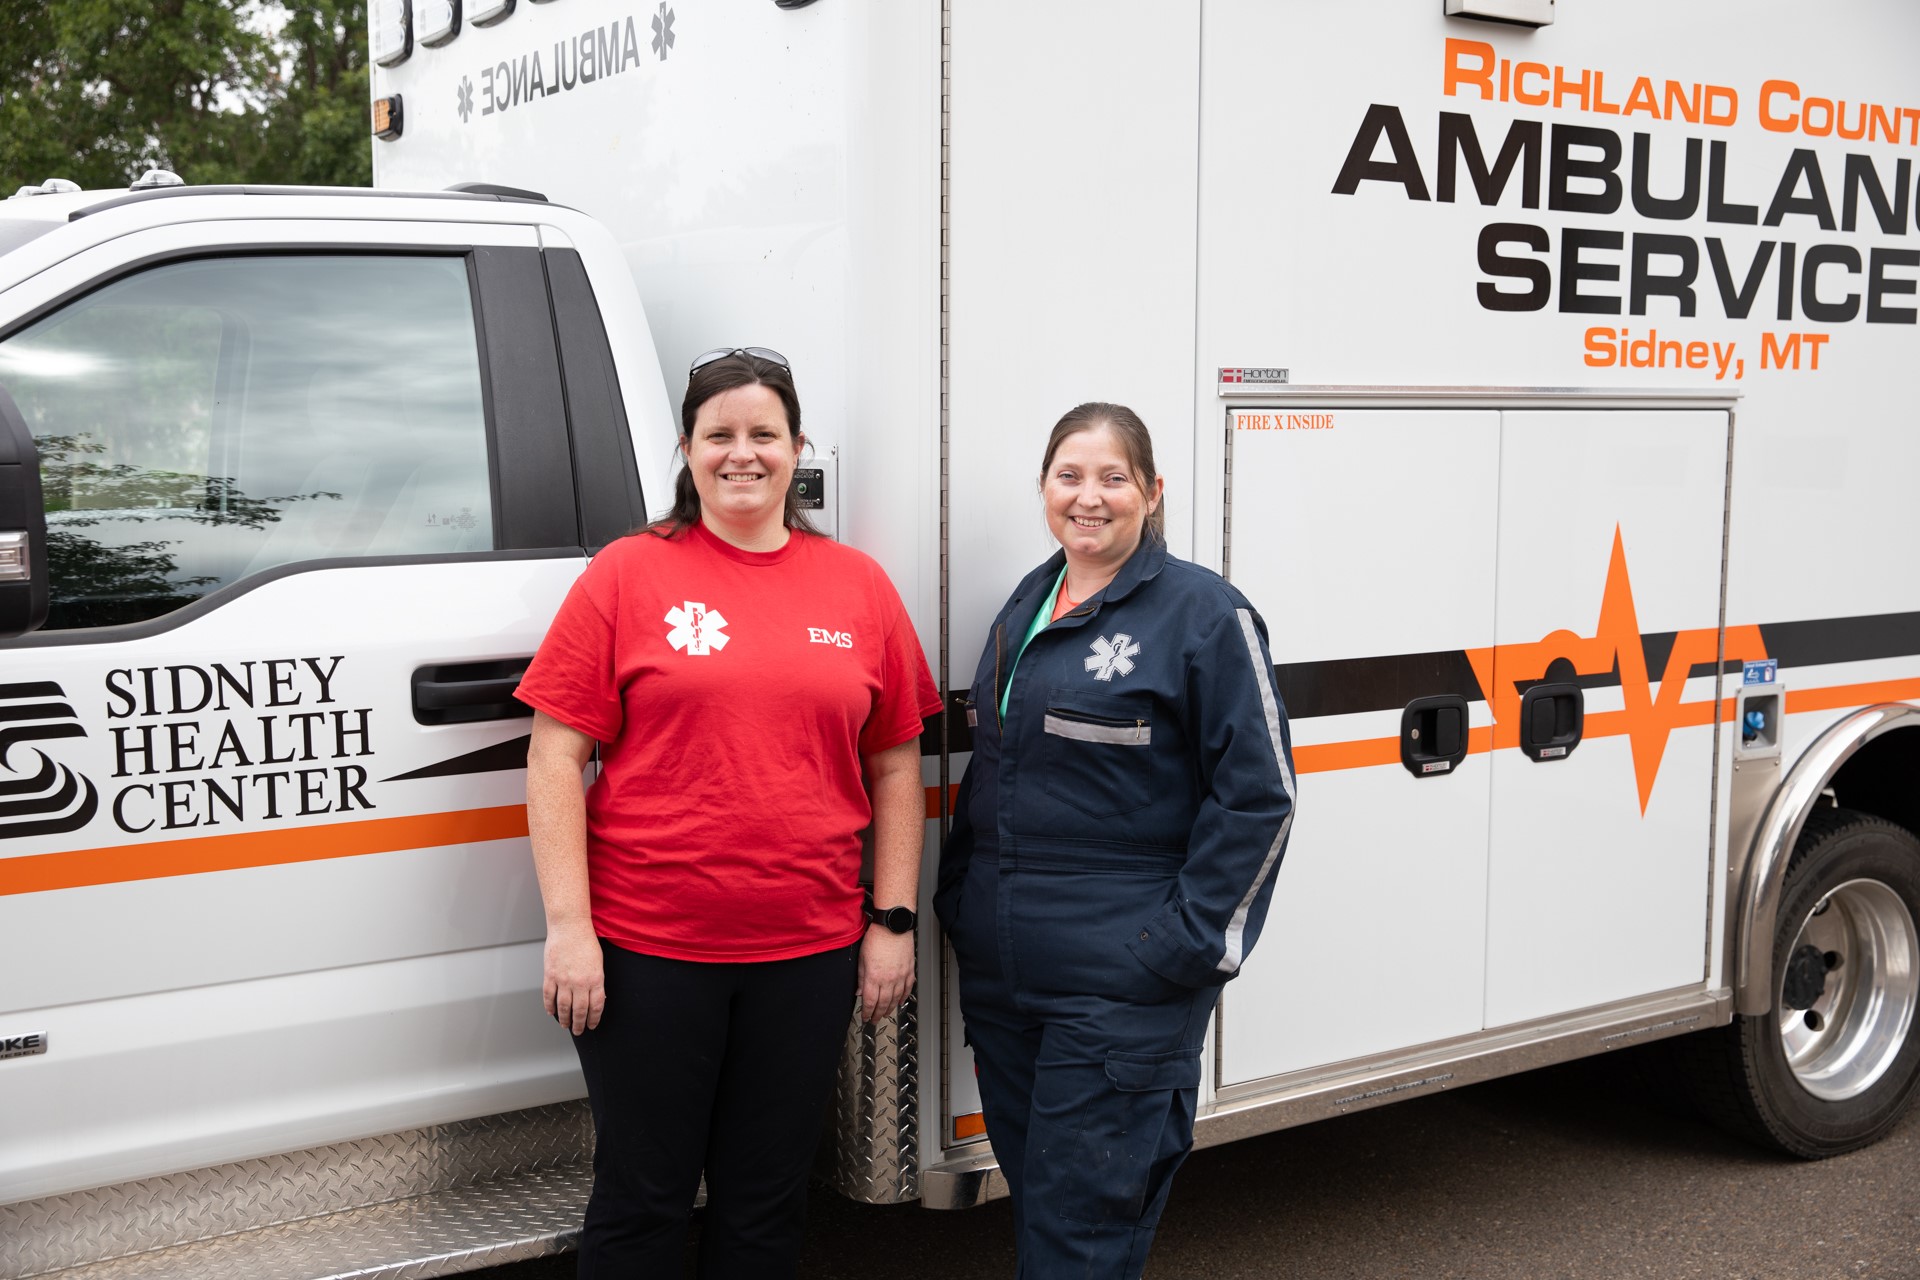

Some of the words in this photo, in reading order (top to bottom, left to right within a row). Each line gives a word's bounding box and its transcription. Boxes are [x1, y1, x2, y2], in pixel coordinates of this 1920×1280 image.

[1443, 37, 1738, 127] RICHLAND
[1331, 104, 1920, 235] AMBULAN
[1477, 223, 1920, 324] SERVICE
[1584, 326, 1744, 380] Sidney,
[1760, 332, 1830, 370] MT
[1238, 415, 1270, 430] FIRE
[1274, 415, 1283, 430] X
[1287, 414, 1334, 430] INSIDE
[807, 627, 852, 649] EMS
[106, 656, 344, 718] SIDNEY
[109, 709, 374, 777] HEALTH
[113, 765, 376, 833] CENTER
